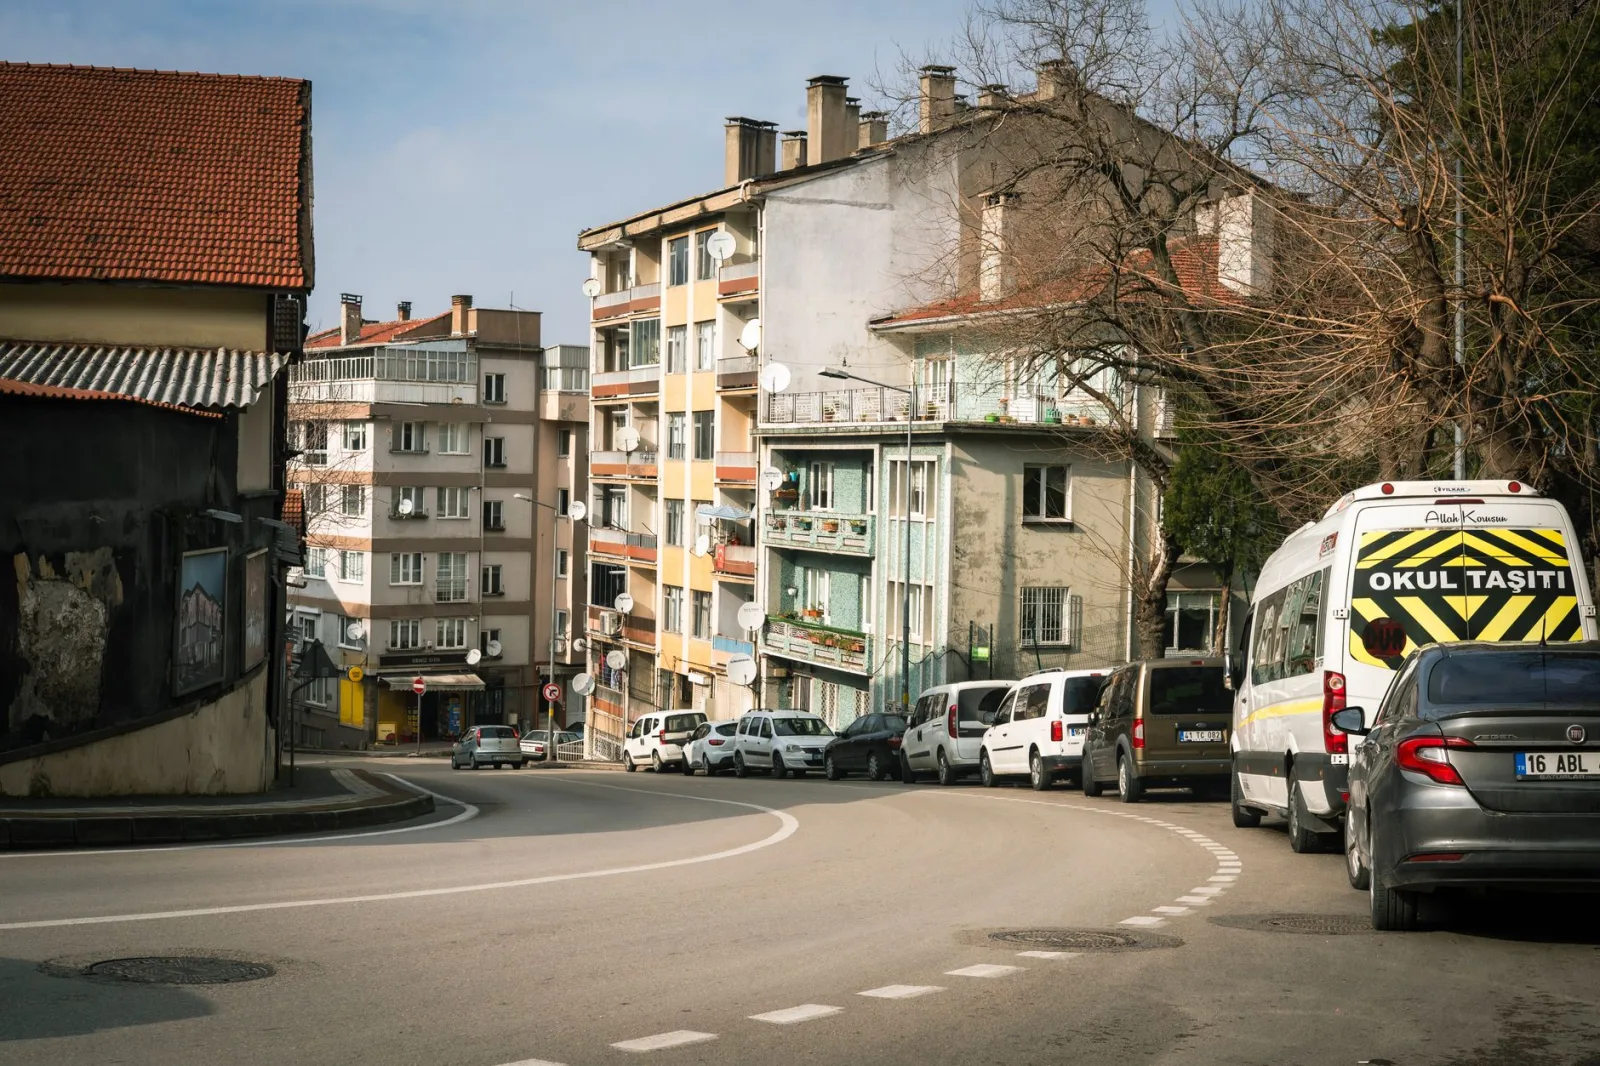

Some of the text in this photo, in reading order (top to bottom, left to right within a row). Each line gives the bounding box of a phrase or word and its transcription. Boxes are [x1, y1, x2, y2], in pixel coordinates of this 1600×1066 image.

[1424, 509, 1509, 523] Allah Korusun
[1369, 570, 1566, 593] OKUL TAŞITI
[1528, 755, 1546, 773] 16
[1556, 755, 1588, 772] ABL
